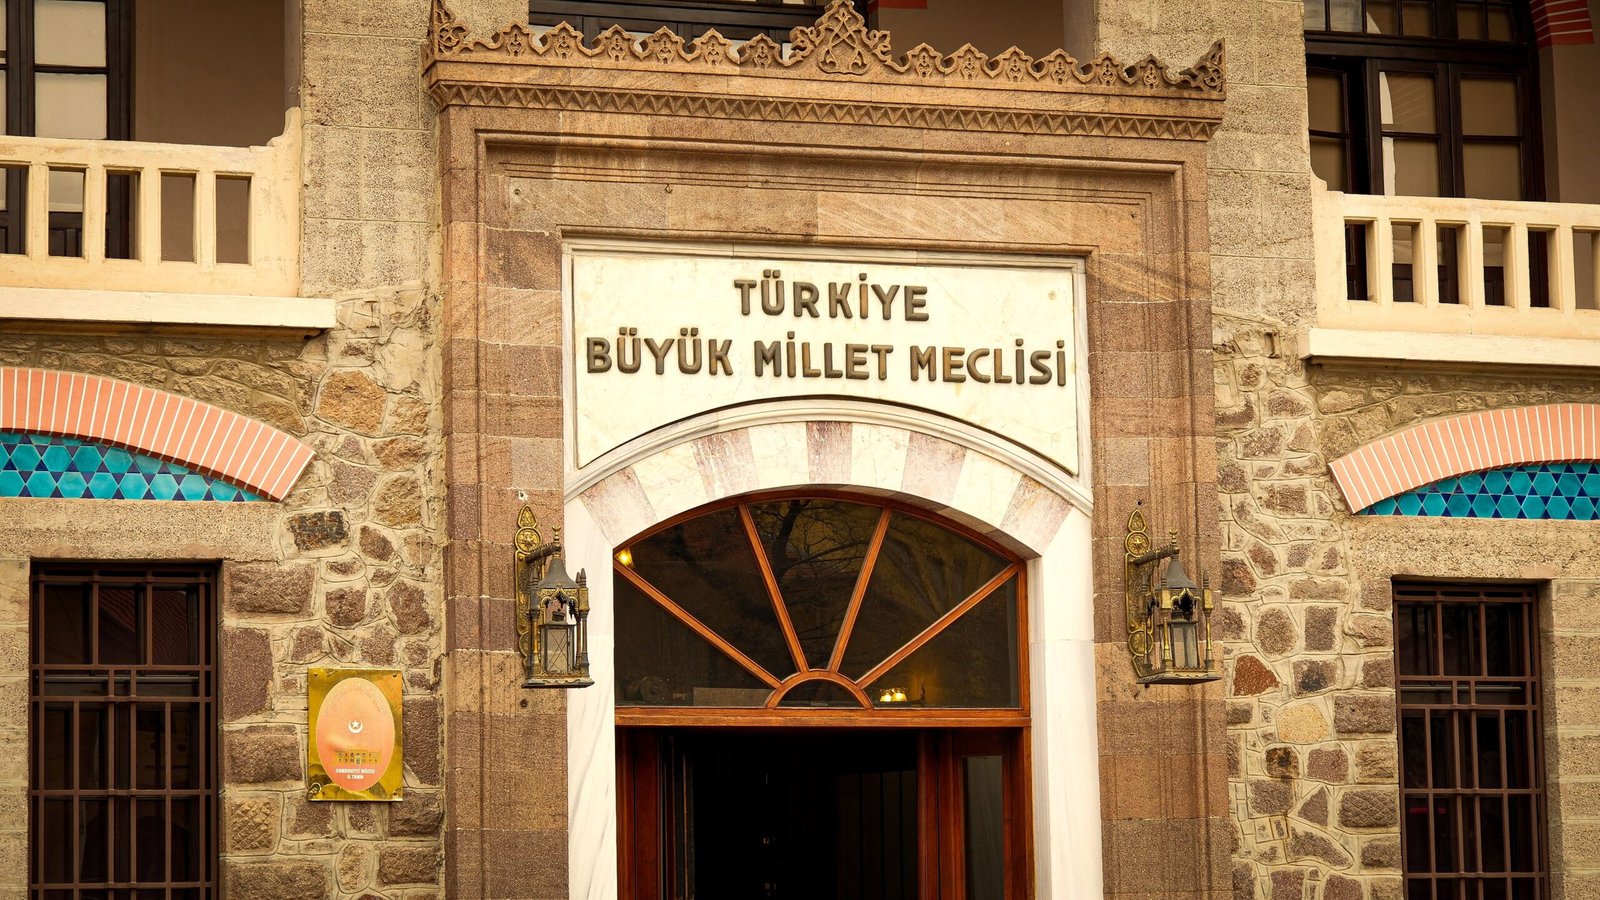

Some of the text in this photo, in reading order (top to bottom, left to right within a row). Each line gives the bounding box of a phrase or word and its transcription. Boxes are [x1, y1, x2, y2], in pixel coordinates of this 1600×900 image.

[734, 269, 930, 321] TÜRKİYE
[586, 327, 1067, 387] BÜYÜK MİLLET MECLİSİ
